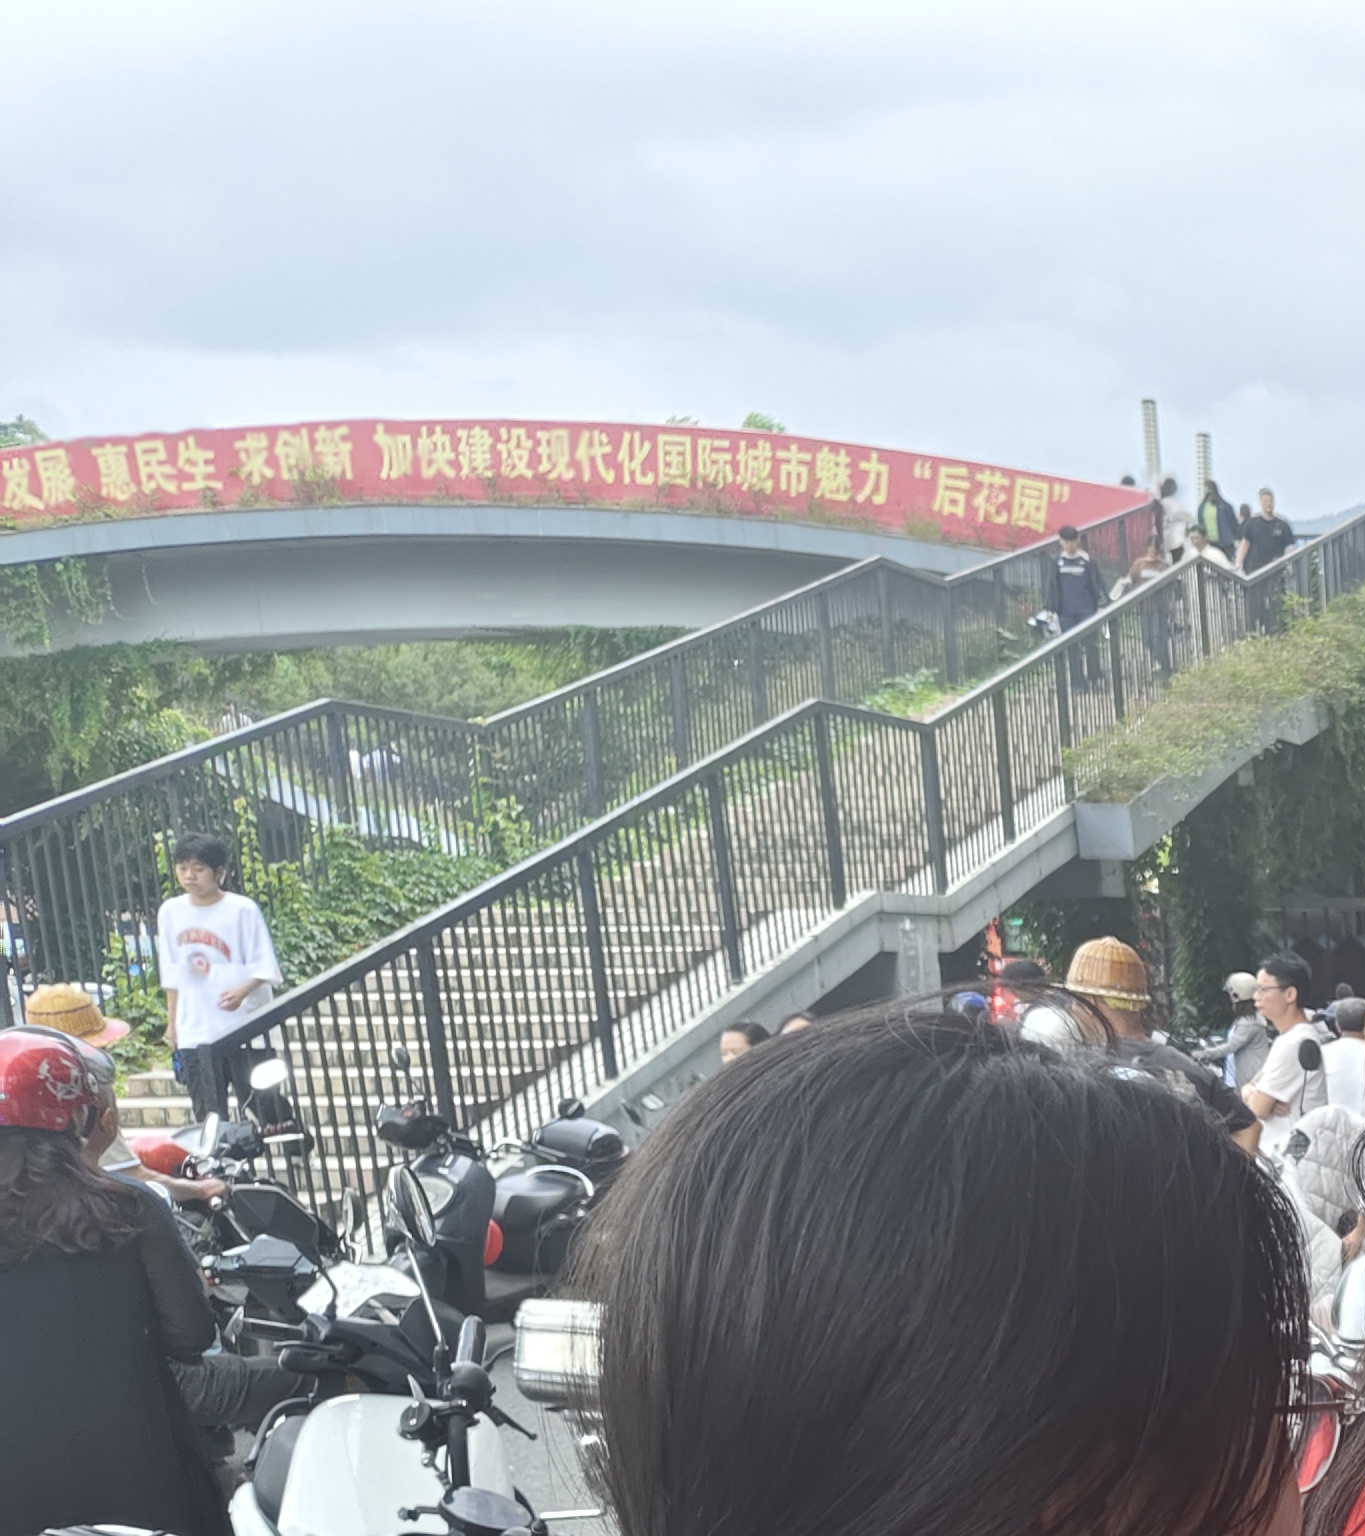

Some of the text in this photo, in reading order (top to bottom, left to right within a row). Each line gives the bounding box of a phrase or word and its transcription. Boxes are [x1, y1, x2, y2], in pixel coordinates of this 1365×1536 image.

[91, 435, 223, 500] 惠民生
[373, 423, 889, 505] 加快建设现代化国际城市魅力
